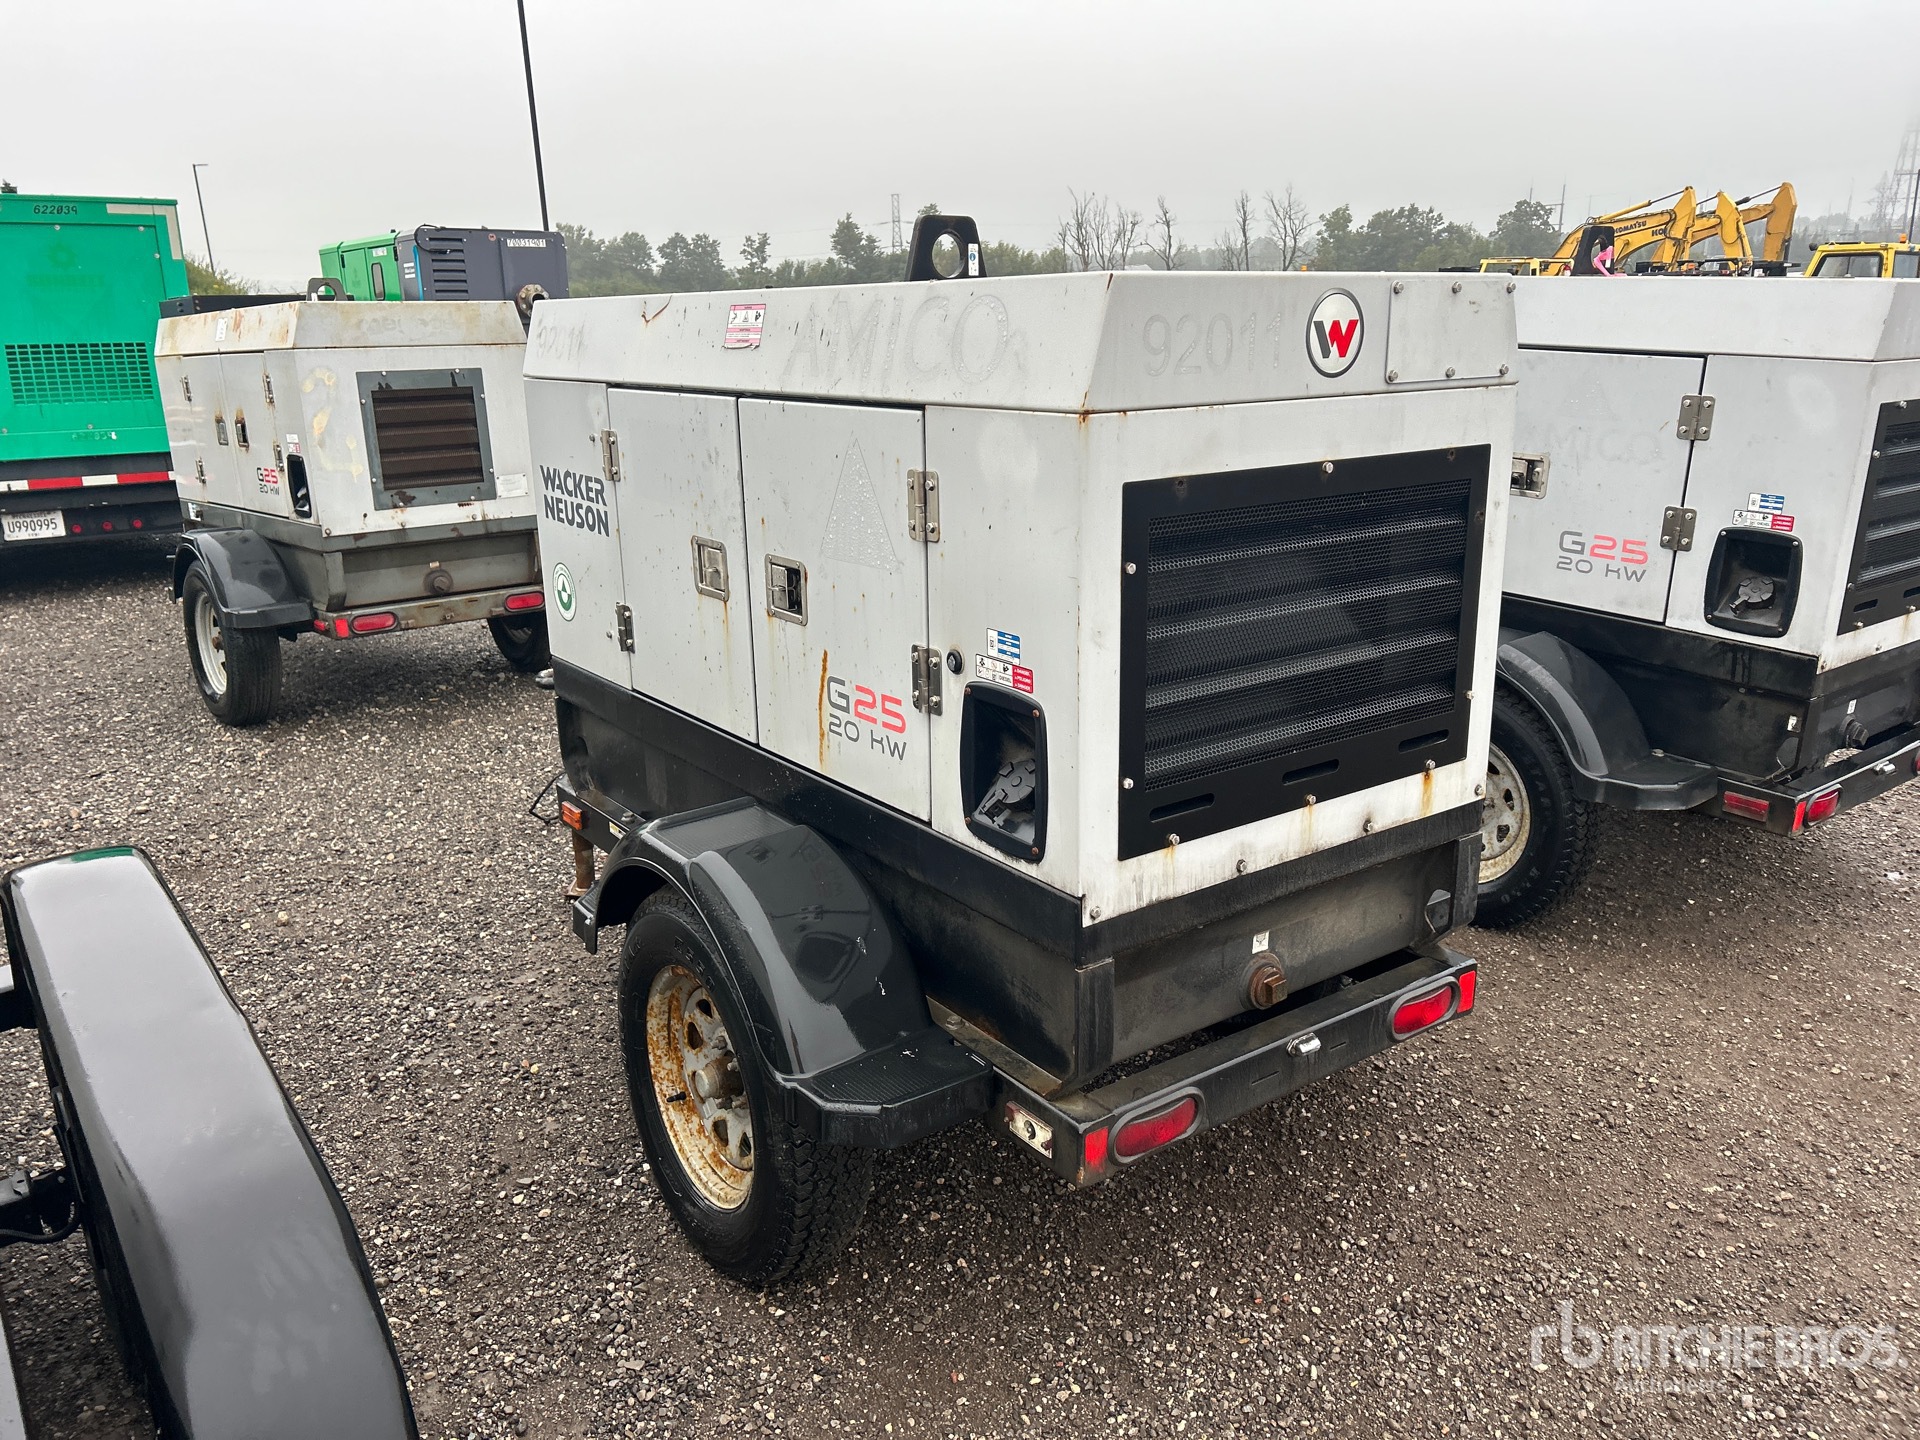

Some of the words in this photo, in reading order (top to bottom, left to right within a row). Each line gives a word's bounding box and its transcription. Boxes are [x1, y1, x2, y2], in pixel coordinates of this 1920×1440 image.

[33, 204, 78, 215] 622039
[780, 293, 1010, 391] AMICO
[1143, 311, 1282, 377] 92011
[257, 467, 278, 484] G25
[539, 464, 608, 507] WACKER
[7, 517, 58, 533] U990995
[543, 493, 610, 538] NEUSON
[1556, 555, 1593, 574] 20
[1559, 530, 1649, 565] G25
[827, 676, 906, 734] G25
[828, 712, 860, 743] 20
